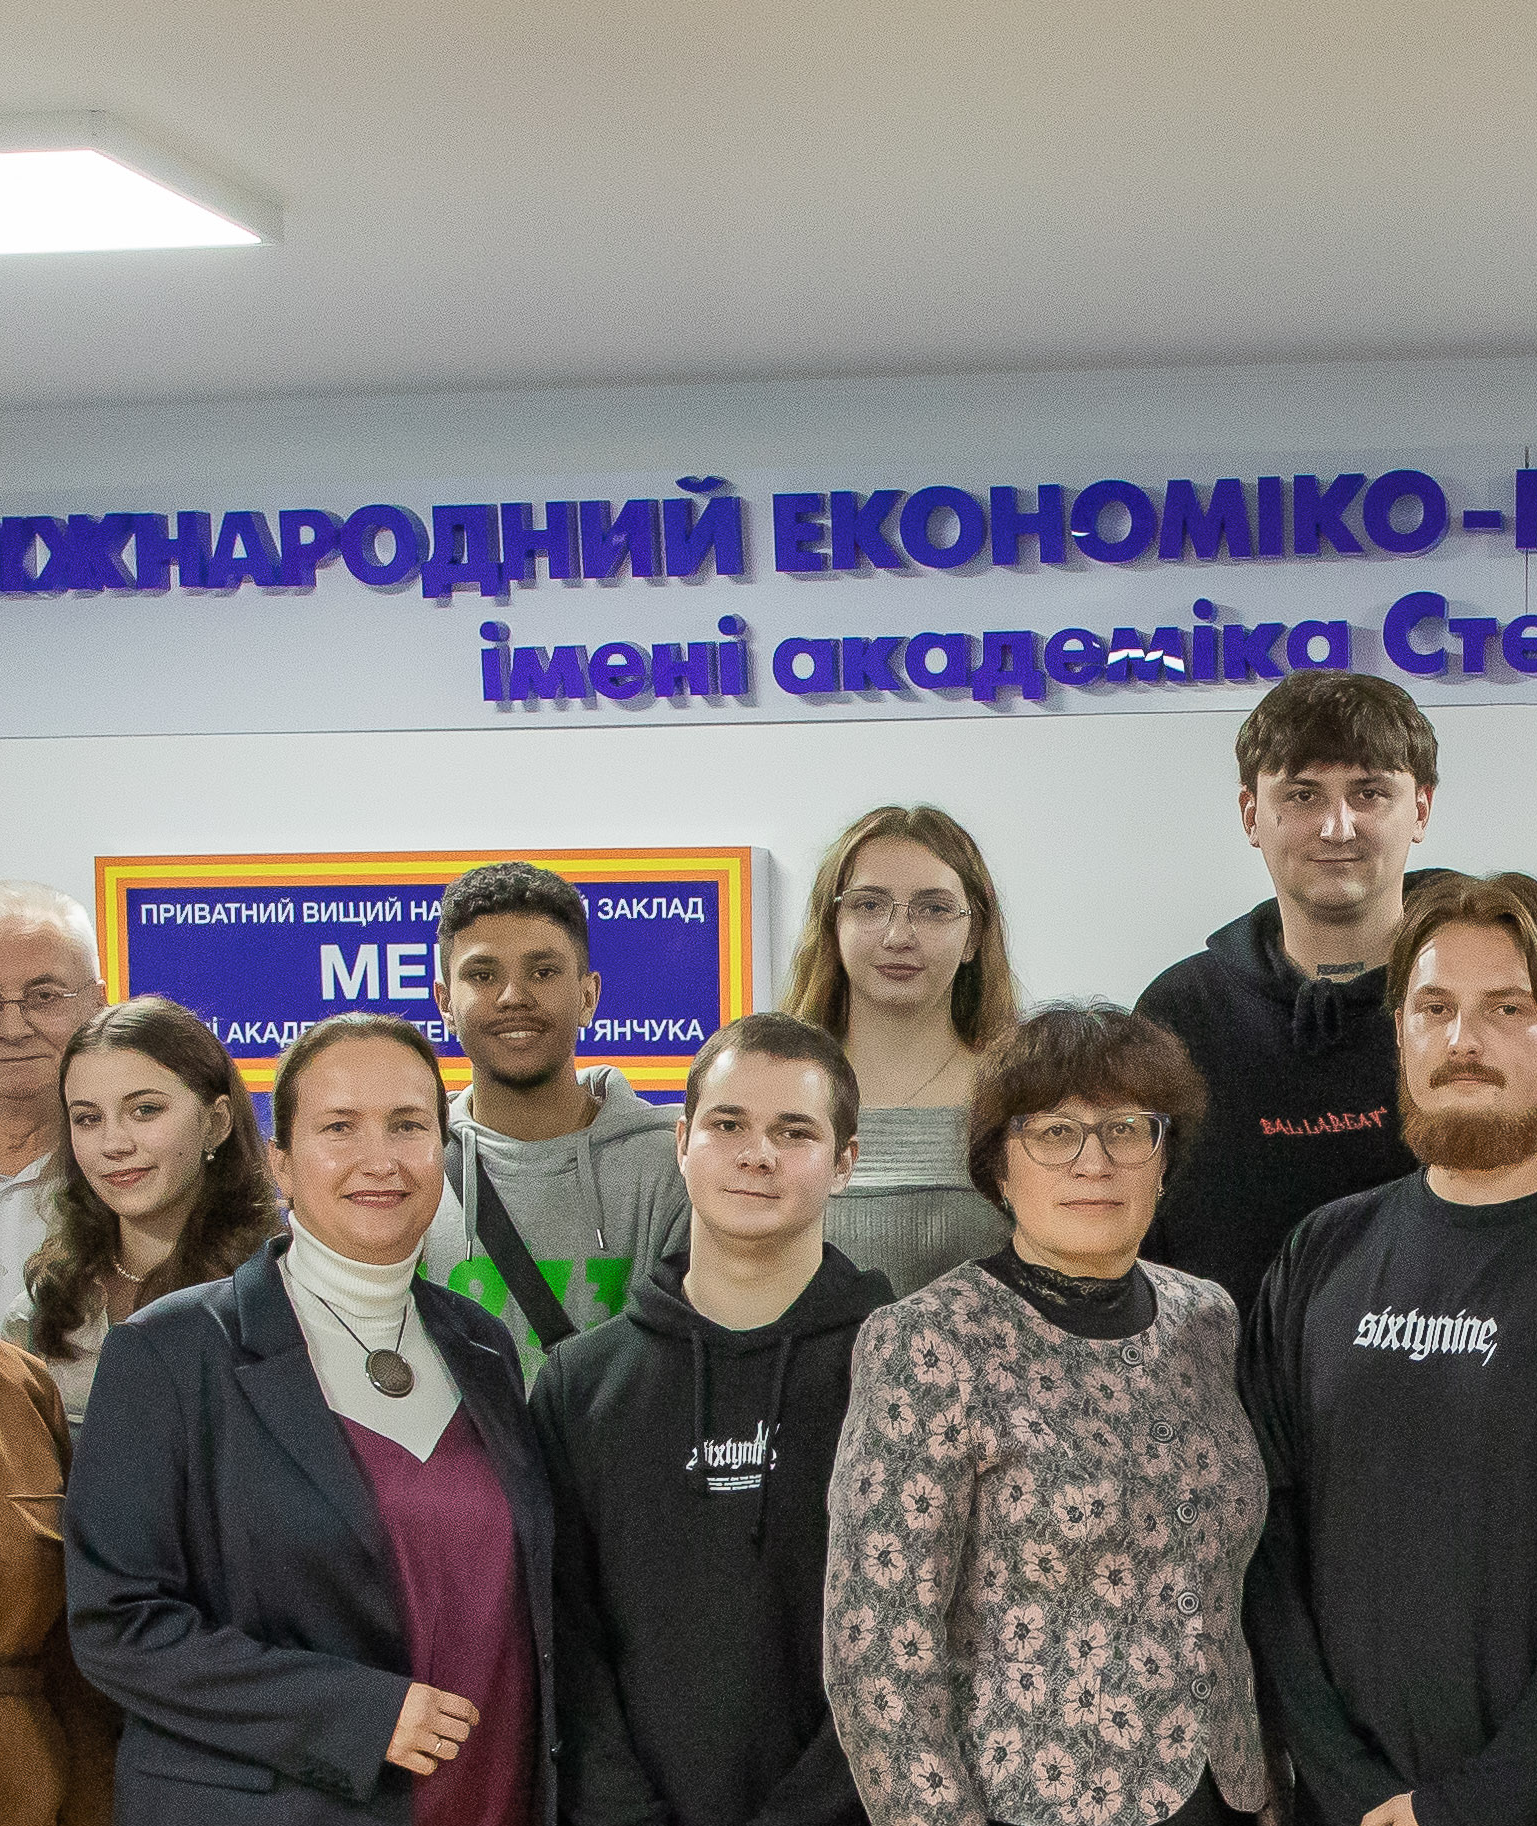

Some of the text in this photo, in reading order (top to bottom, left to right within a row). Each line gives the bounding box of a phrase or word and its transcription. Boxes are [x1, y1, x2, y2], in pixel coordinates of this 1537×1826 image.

[479, 614, 749, 702] імені
[772, 598, 1351, 701] академіка
[140, 897, 294, 925] ПРИВАТНИЙ
[303, 896, 402, 927] ВИЩИЙ
[597, 897, 705, 923] ЗАКЛАД
